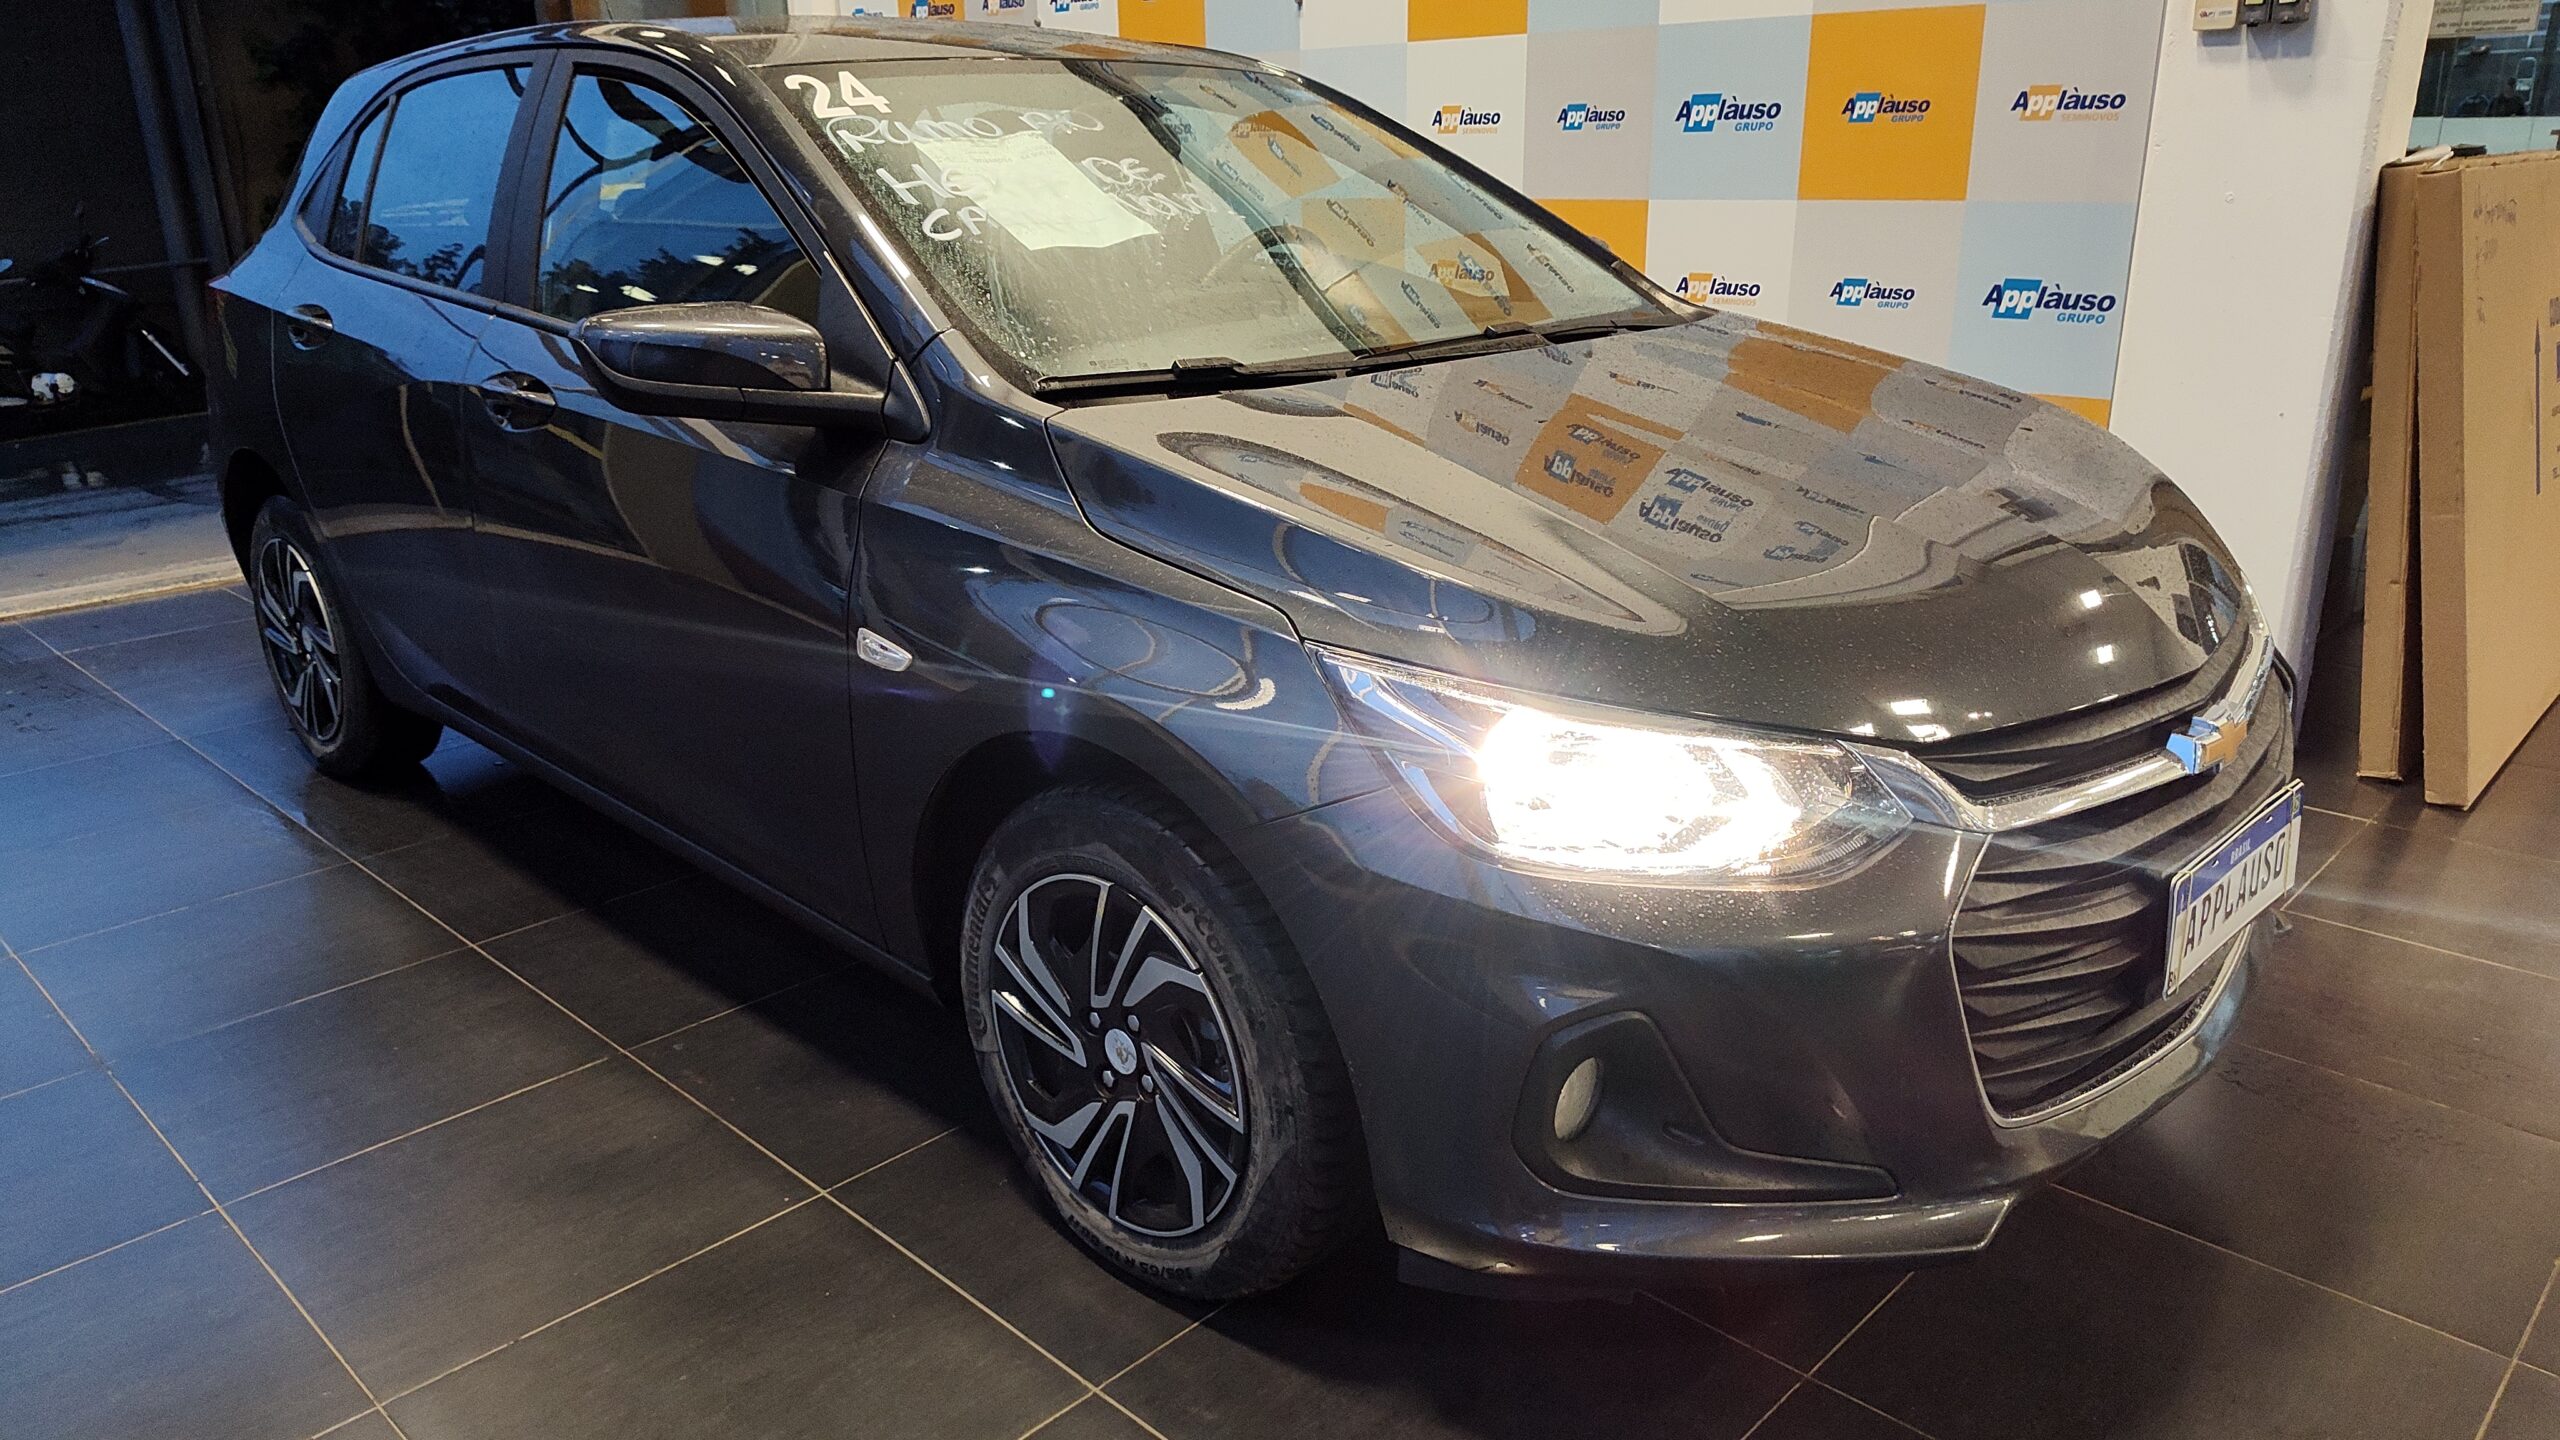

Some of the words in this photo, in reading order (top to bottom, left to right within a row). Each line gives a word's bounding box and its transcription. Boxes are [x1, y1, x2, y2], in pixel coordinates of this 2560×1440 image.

[784, 71, 891, 119] 24
[1891, 114, 1924, 123] GRUPO
[1595, 122, 1621, 130] GRUPO
[1734, 121, 1774, 132] GRUPO
[1877, 301, 1909, 309] GRUPO
[2056, 312, 2106, 324] GRUPO
[2183, 831, 2287, 958] APPLAUSO
